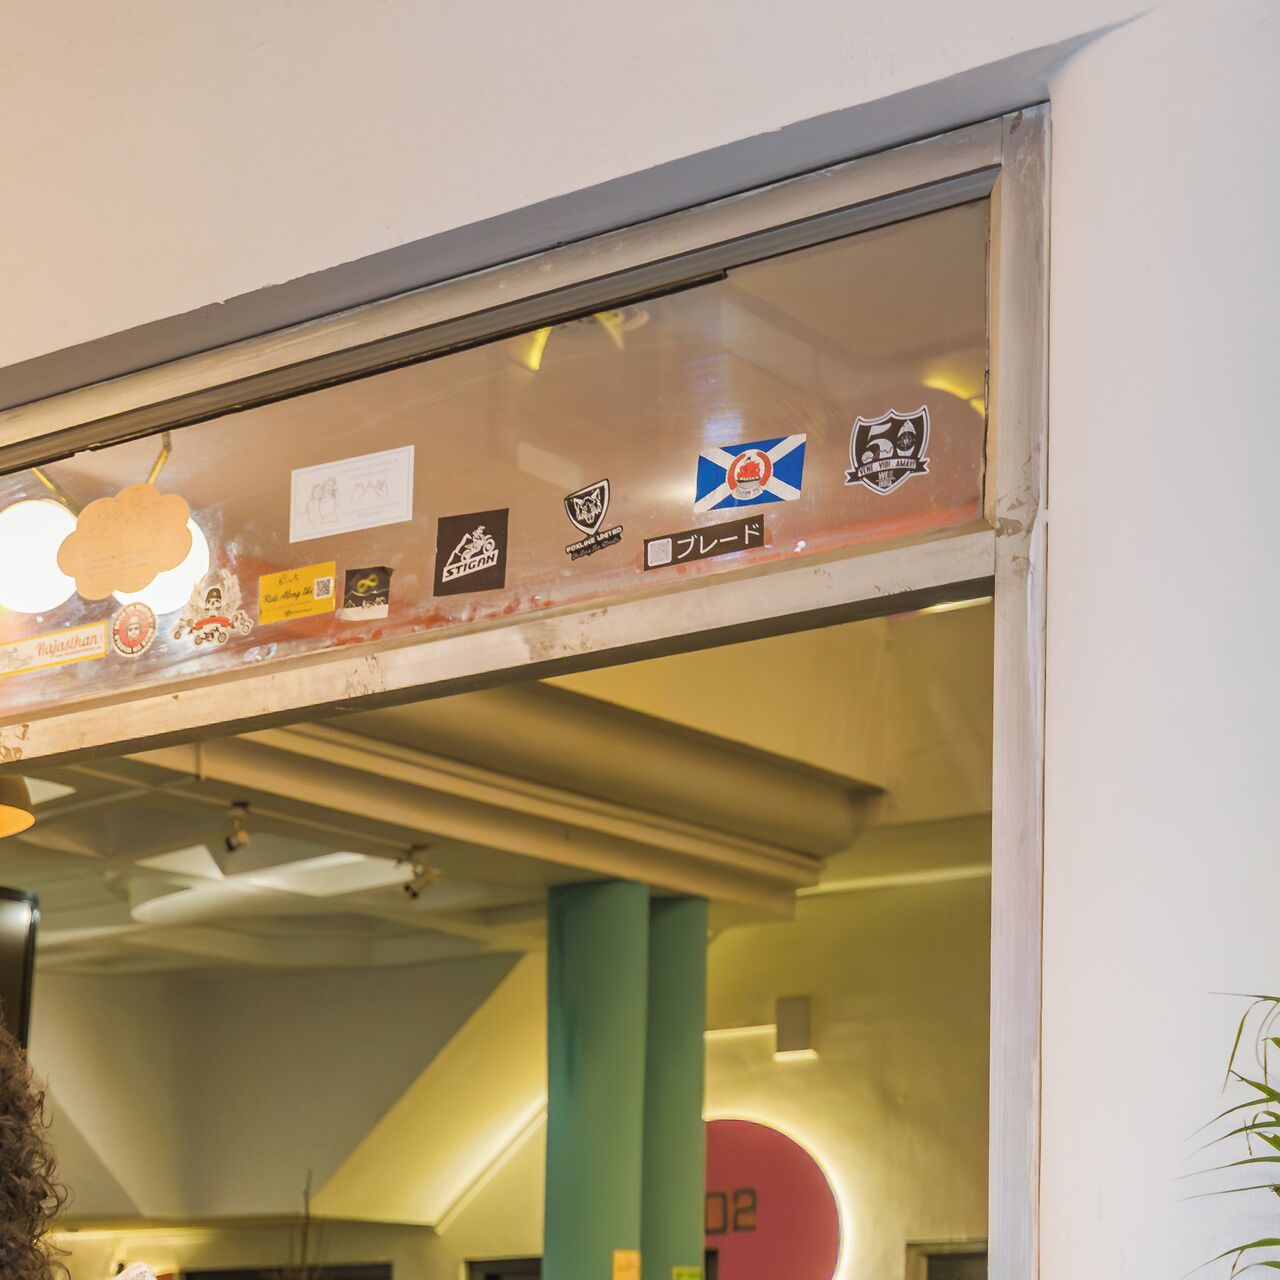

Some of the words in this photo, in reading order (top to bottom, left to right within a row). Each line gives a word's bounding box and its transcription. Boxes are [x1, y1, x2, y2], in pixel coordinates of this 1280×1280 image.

[596, 526, 622, 541] UNITED
[677, 523, 760, 559] ブレード
[444, 552, 496, 579] STIGAN
[36, 634, 97, 657] Rajasthan
